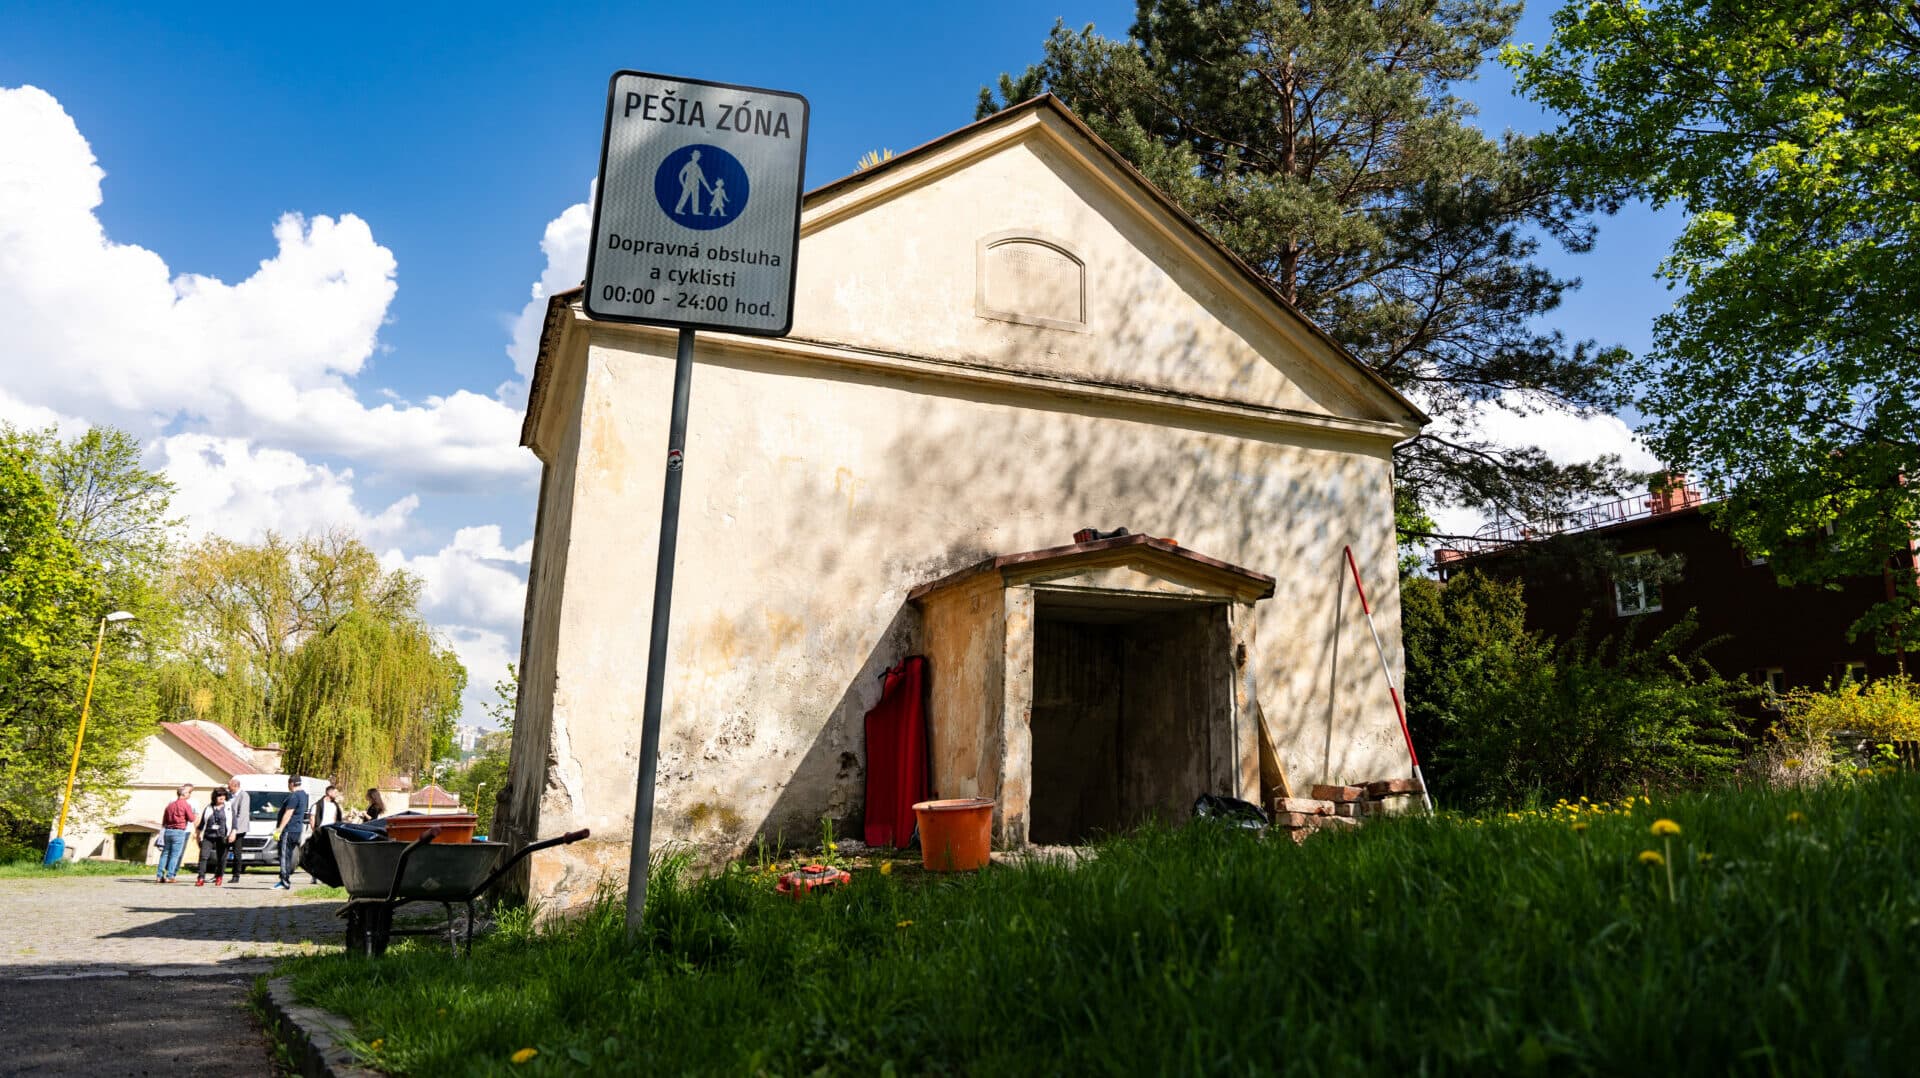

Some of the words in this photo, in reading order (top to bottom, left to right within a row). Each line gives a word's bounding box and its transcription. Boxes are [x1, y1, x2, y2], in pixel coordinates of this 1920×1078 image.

[624, 89, 706, 128] PEŠIA
[716, 100, 791, 139] ZÓNA
[608, 234, 700, 258] Dopravná
[707, 247, 781, 267] obsluha
[650, 268, 661, 280] a
[668, 269, 736, 287] cyklisti
[603, 285, 655, 305] 00:00
[677, 292, 728, 312] 24:00
[736, 298, 776, 317] hod.
